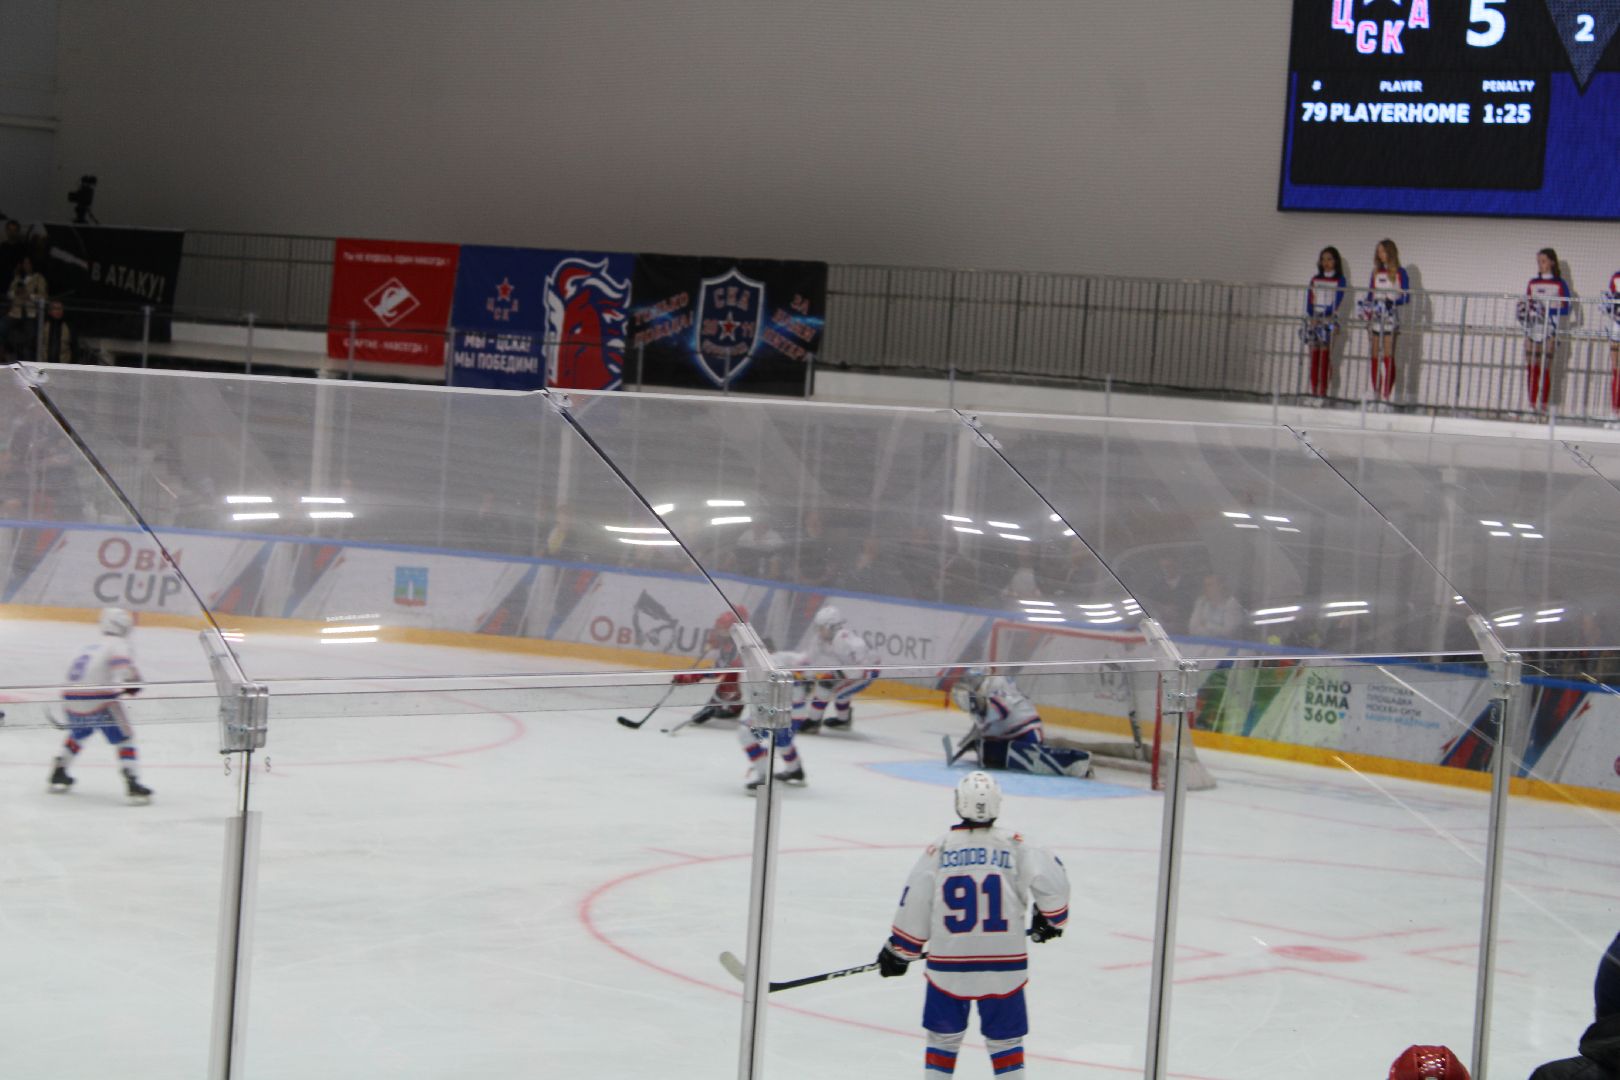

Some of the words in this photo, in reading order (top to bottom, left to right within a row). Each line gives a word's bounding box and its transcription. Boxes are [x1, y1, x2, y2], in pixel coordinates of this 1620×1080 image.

[1466, 0, 1506, 47] 5
[1574, 14, 1596, 42] 2
[1379, 80, 1422, 93] PLAYER
[1482, 80, 1535, 93] PENALTY
[1301, 102, 1328, 122] 79
[1330, 103, 1470, 124] PLAYERHOME
[1483, 104, 1531, 124] 1:25
[454, 352, 476, 368] МЫ
[93, 572, 182, 606] CUP
[1304, 693, 1349, 710] RAMA
[1304, 707, 1338, 724] 360
[939, 848, 987, 868] ОЗЛОВ
[942, 873, 1008, 934] 91
